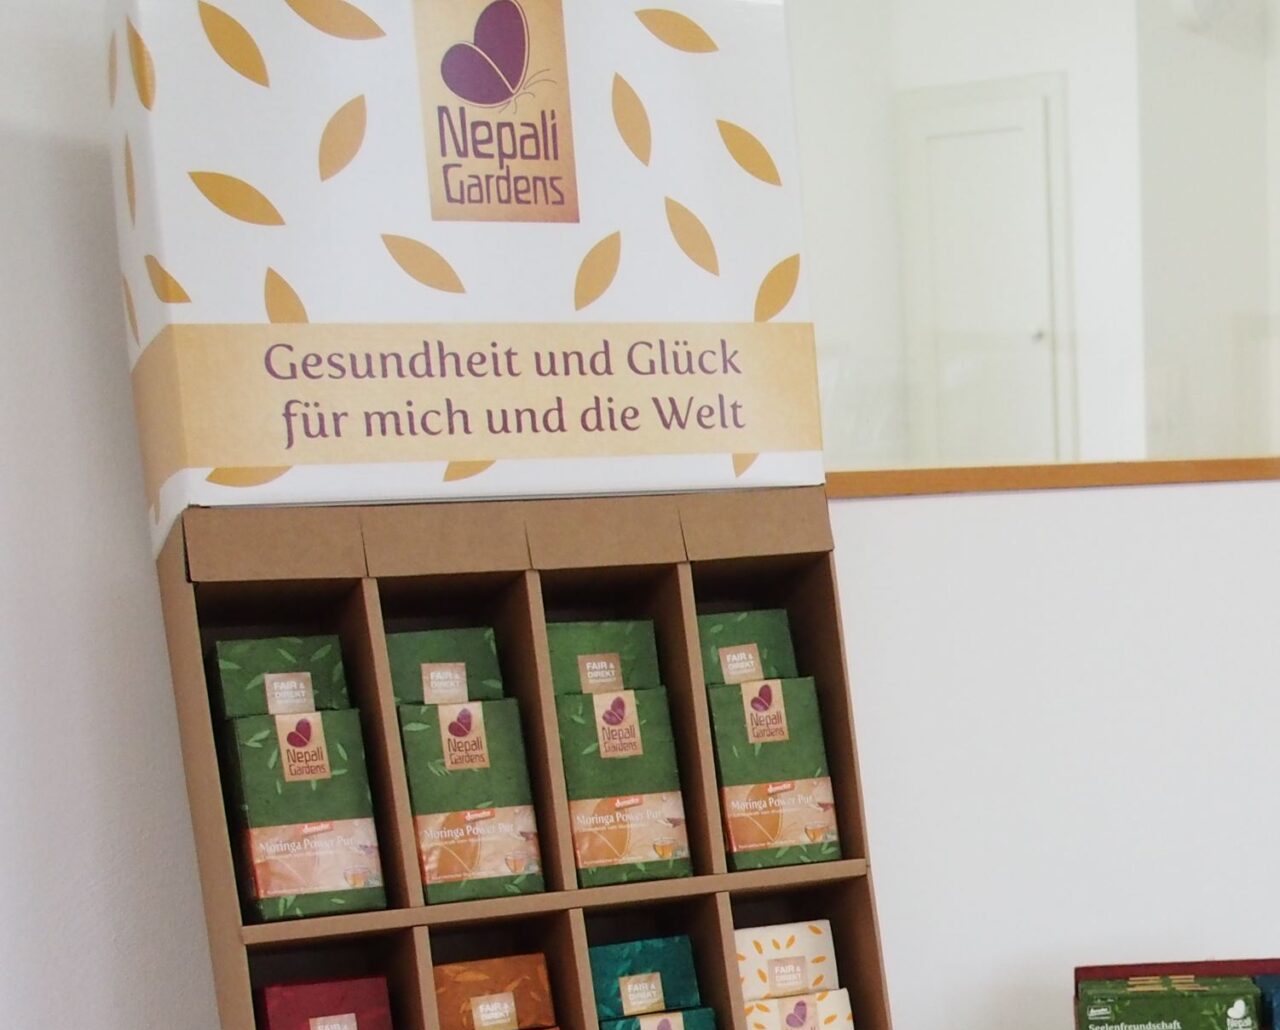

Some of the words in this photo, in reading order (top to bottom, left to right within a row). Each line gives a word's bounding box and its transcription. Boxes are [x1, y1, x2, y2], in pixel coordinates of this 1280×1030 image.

[437, 106, 560, 169] Nepali
[443, 163, 565, 207] Gardens
[263, 340, 519, 382] Gesundheit
[535, 340, 612, 378] und
[627, 338, 741, 376] Glück
[282, 400, 348, 450] für
[364, 399, 472, 438] mich
[487, 398, 566, 435] und
[580, 397, 640, 433] die
[652, 394, 745, 430] Welt
[586, 661, 607, 670] FAIR
[750, 712, 782, 728] Nepali
[602, 725, 636, 742] Nepali
[752, 726, 784, 738] Gardens
[447, 737, 482, 755] Nepali
[603, 741, 637, 753] Gardens
[286, 747, 323, 765] Nepali
[450, 752, 486, 765] Gardens
[289, 763, 326, 776] Gardens
[731, 798, 767, 810] Moringa
[576, 813, 614, 826] Moringa
[615, 811, 643, 823] Power
[424, 825, 464, 840] Moringa
[259, 839, 301, 854] Moringa
